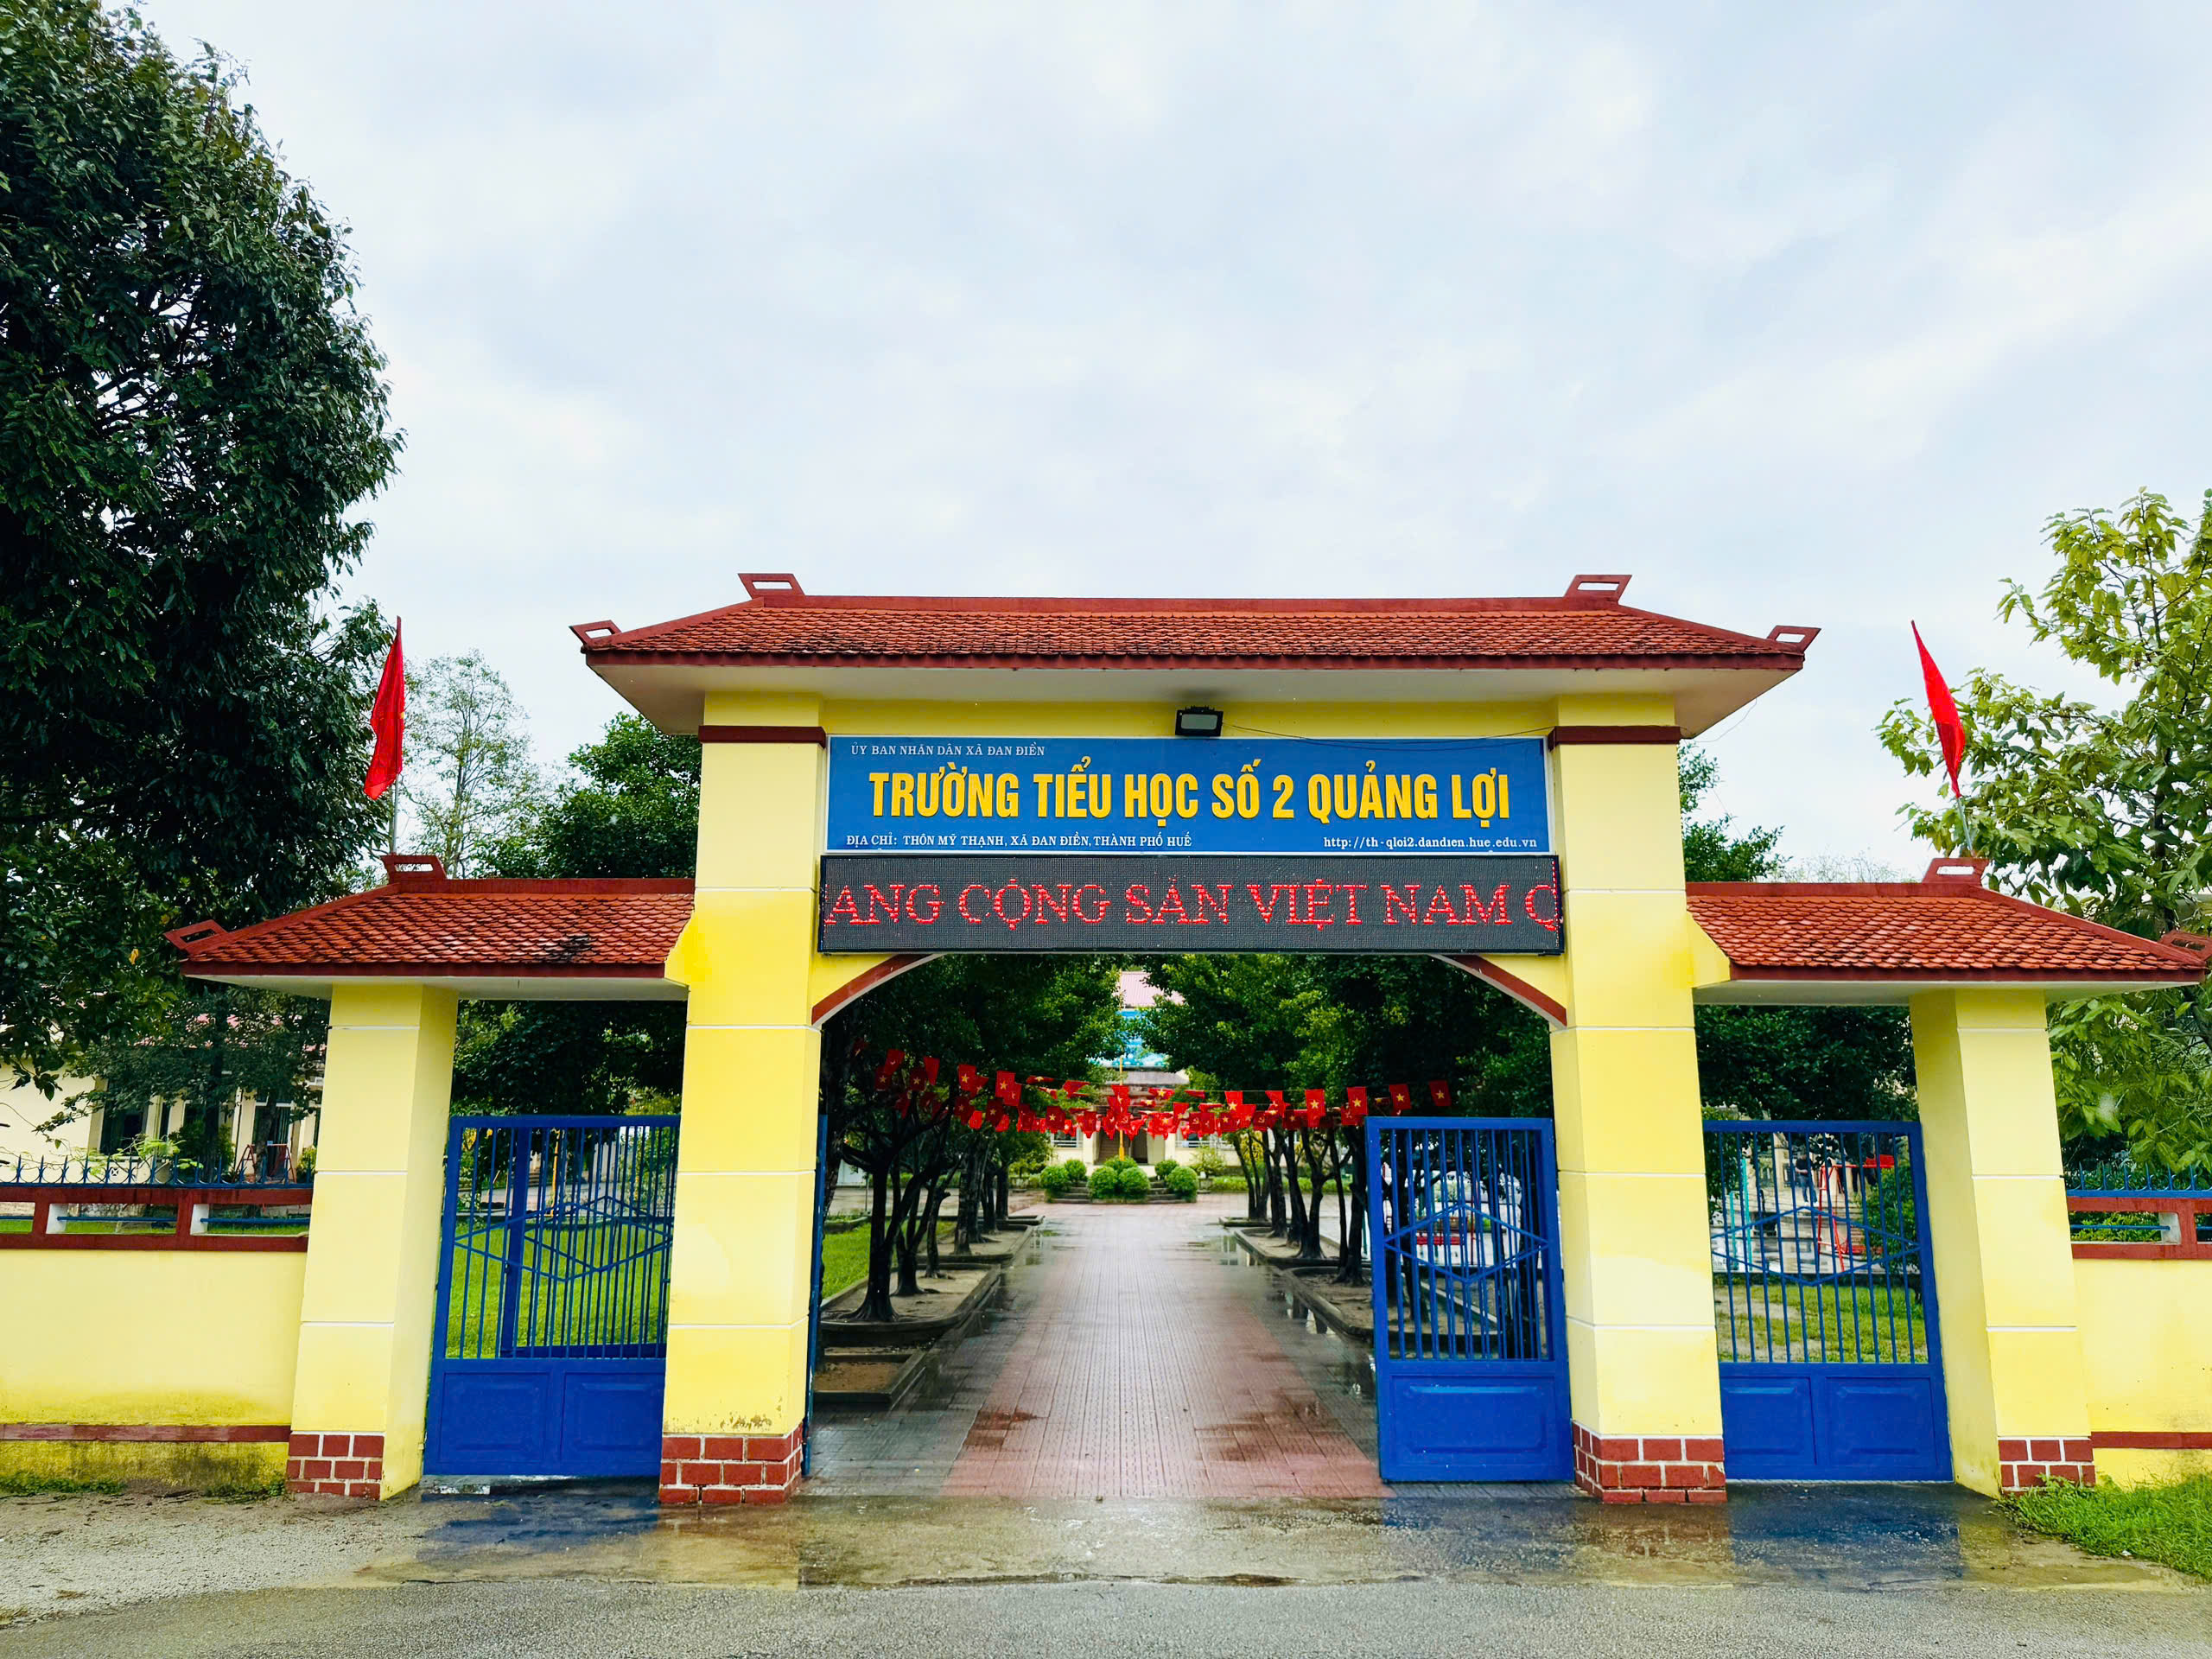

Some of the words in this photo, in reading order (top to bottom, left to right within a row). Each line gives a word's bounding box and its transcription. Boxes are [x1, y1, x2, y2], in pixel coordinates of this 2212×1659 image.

[851, 741, 868, 755] ỦY
[871, 745, 896, 755] BAN
[899, 743, 935, 756] NHÂN
[937, 743, 963, 756] DÂN
[965, 743, 983, 756] XÃ
[987, 745, 1013, 756] ĐAN
[1015, 741, 1045, 756] ĐIỀN
[869, 762, 1020, 818] TRƯỜNG
[1033, 756, 1112, 818] TIỂU
[1125, 773, 1199, 827] HỌC
[1212, 759, 1262, 819] SỐ
[1273, 774, 1294, 819] 2
[1308, 760, 1438, 824] QUẢNG
[1452, 767, 1510, 828] LỢI
[846, 835, 868, 849] ĐỊA
[871, 832, 898, 846] CHỈ:
[902, 833, 935, 846] THÔN
[938, 833, 957, 846] MỸ
[960, 836, 1007, 849] THẠNH,
[1010, 833, 1028, 846] XÃ
[1032, 836, 1057, 847] ĐAN
[1059, 831, 1091, 848] ĐIỀN,
[1093, 833, 1136, 847] THÀNH
[1140, 831, 1164, 847] PHỐ
[1166, 830, 1192, 847] HUẾ
[1380, 884, 1514, 925] NAM
